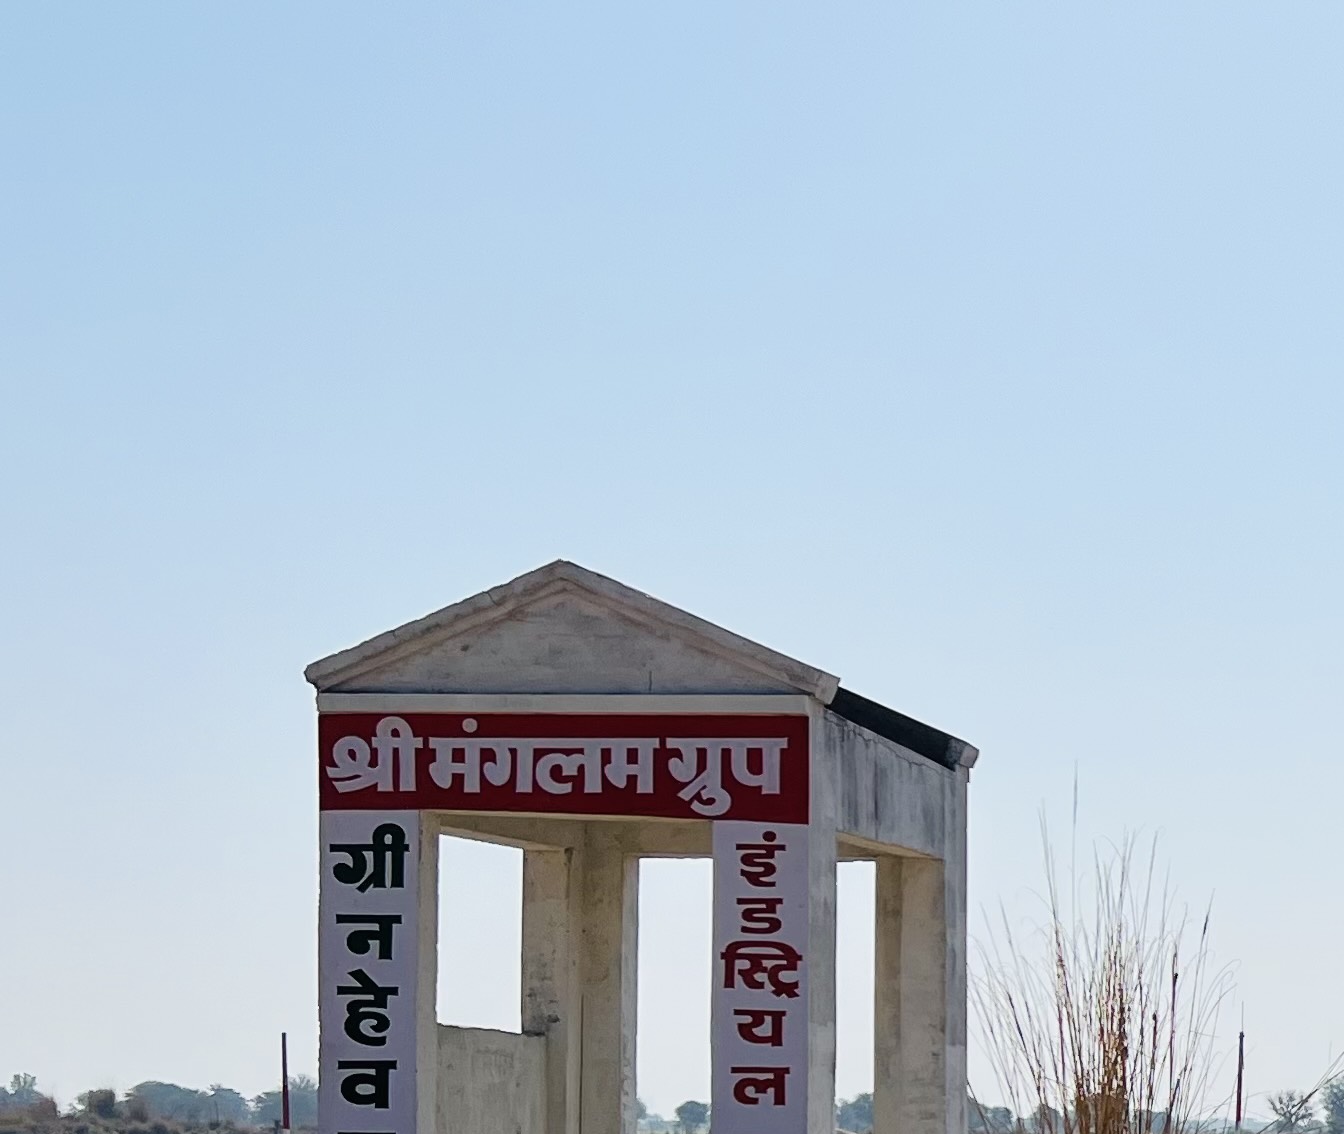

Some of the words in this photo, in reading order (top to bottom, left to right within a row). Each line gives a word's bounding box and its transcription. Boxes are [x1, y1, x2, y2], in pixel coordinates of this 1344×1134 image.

[325, 715, 424, 794] श्री
[428, 716, 660, 795] मंगलम
[665, 736, 789, 817] ग्रुप
